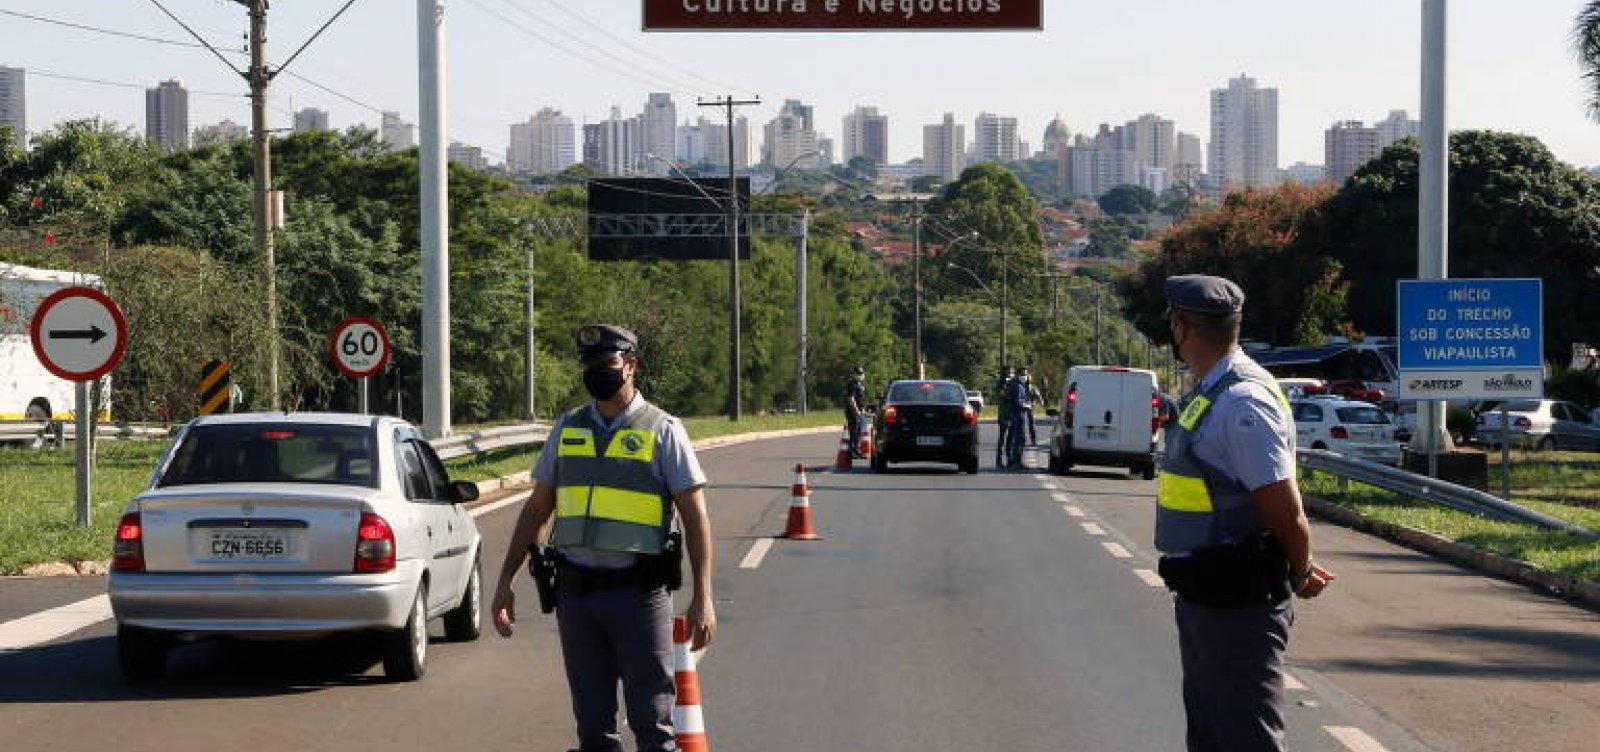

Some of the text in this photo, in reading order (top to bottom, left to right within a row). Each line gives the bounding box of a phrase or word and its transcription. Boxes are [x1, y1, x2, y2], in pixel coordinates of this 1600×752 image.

[683, 0, 806, 12] Cultura
[825, 0, 840, 12] e
[1447, 285, 1491, 301] INÍCIO
[1426, 308, 1512, 321] DO TRECHO
[1409, 327, 1438, 341] SOB
[343, 331, 378, 355] 60
[1424, 346, 1516, 360] VIAPAULISTA
